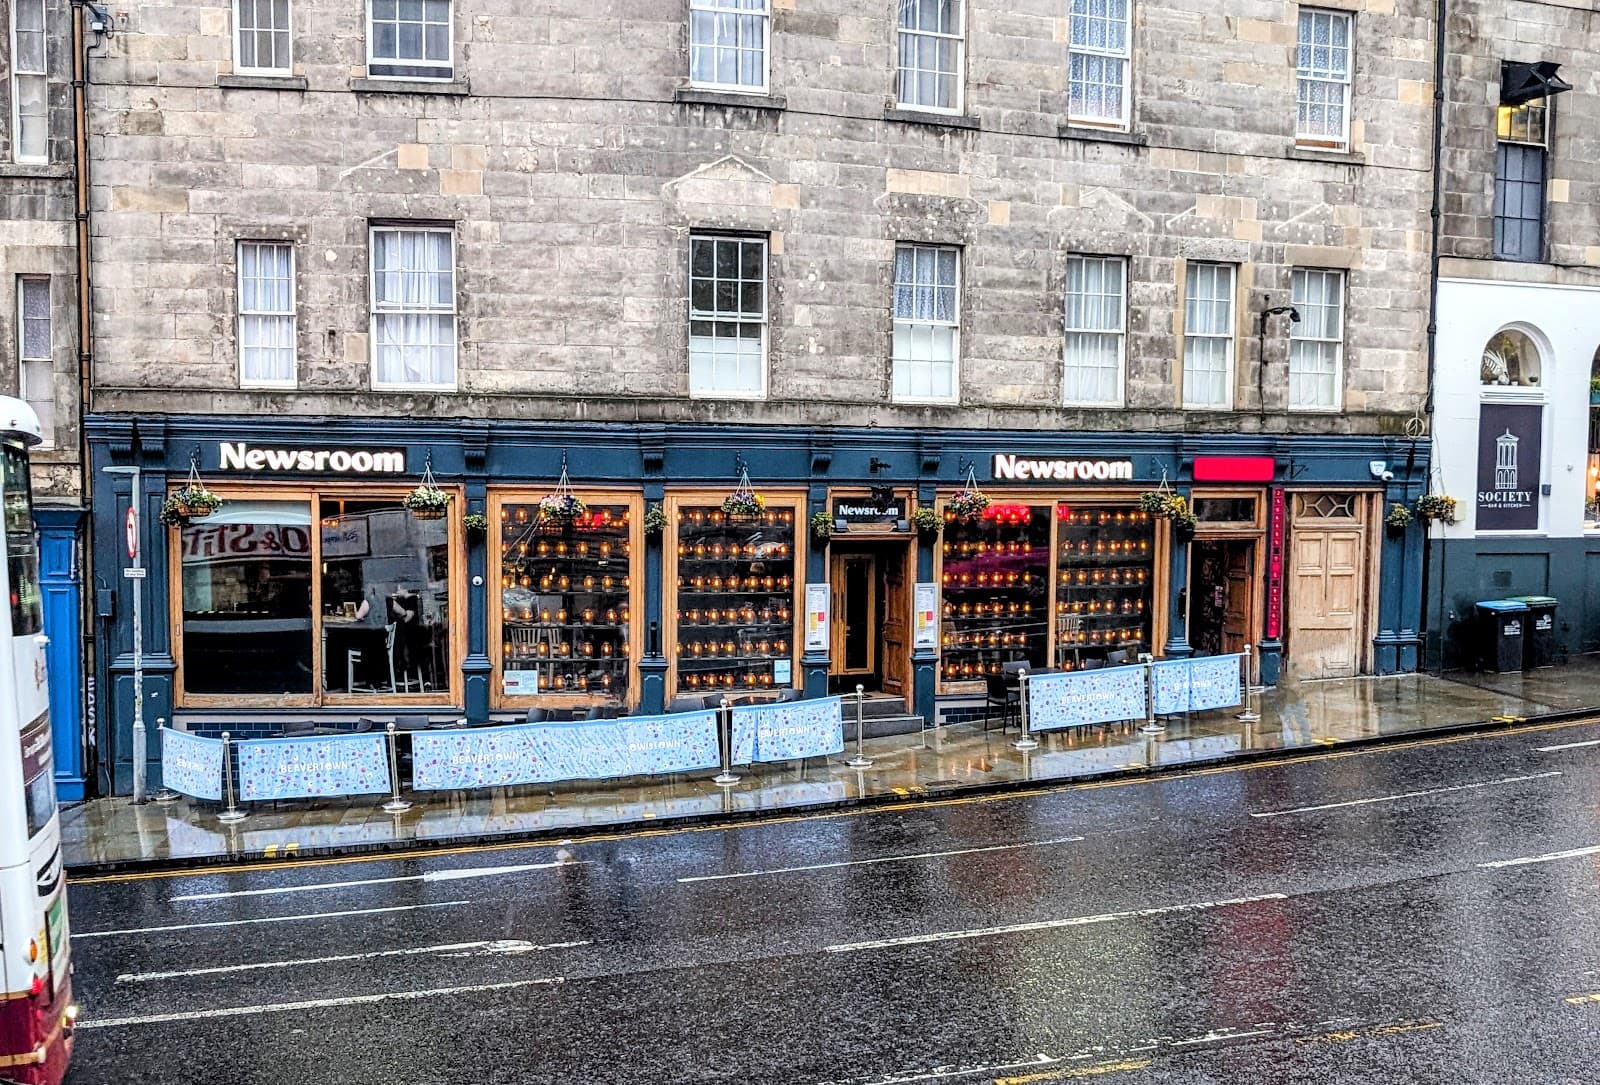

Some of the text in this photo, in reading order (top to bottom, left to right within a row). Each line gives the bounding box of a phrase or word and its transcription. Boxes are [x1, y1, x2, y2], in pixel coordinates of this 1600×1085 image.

[219, 442, 405, 473] Newsroom
[994, 454, 1134, 480] Newsroom
[1478, 491, 1533, 502] SOCIETY
[759, 726, 810, 738] EAVERTOWN
[452, 752, 519, 764] BEAVERTOWN
[280, 761, 349, 773] BEAVERTOWN
